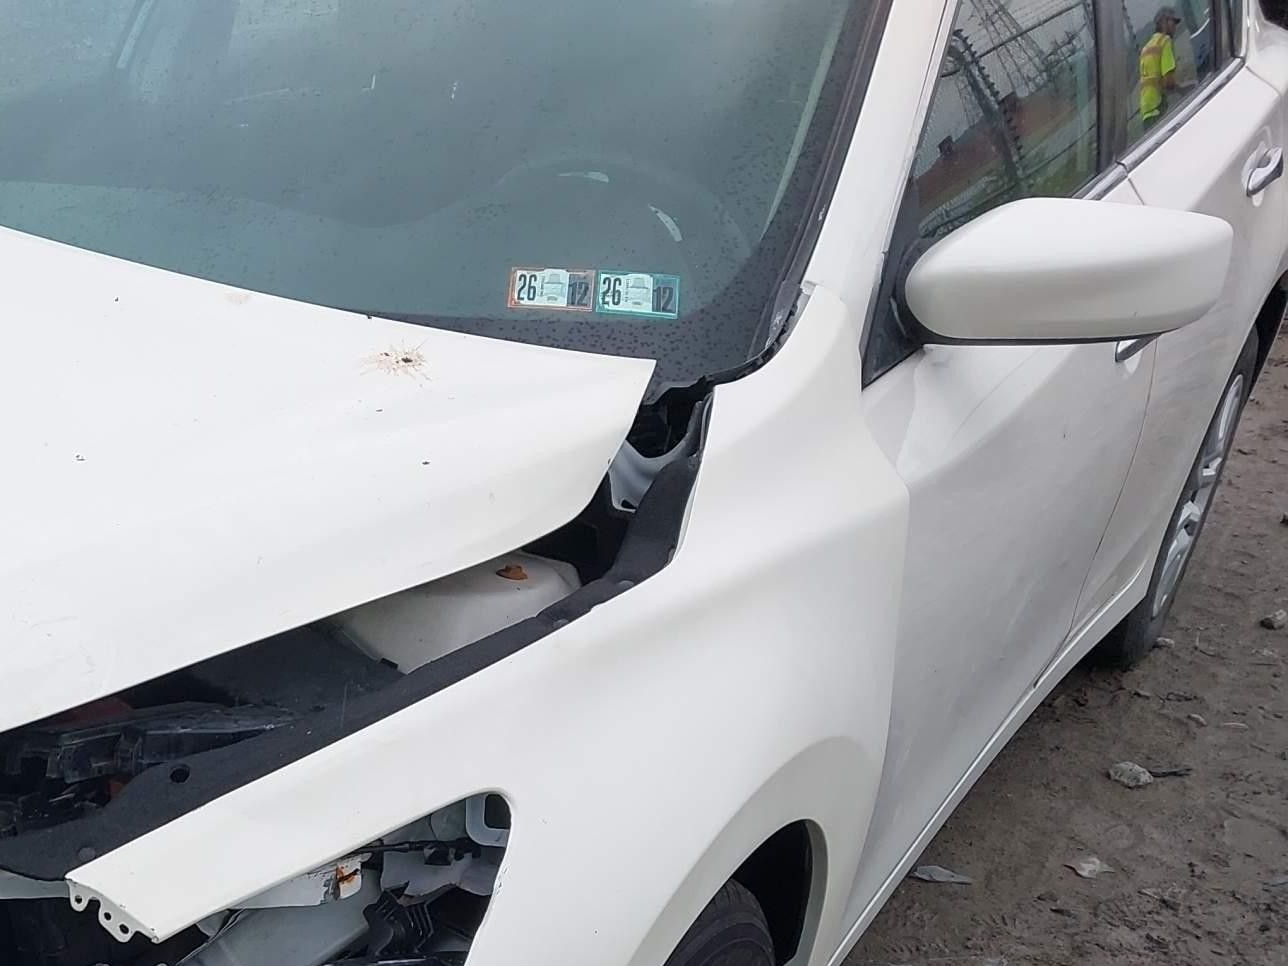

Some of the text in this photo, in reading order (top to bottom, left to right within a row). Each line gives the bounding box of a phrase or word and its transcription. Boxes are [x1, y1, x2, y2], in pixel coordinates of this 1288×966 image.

[516, 273, 537, 301] 26
[568, 281, 589, 306] 12
[601, 276, 622, 306] 26
[652, 286, 674, 312] 12
